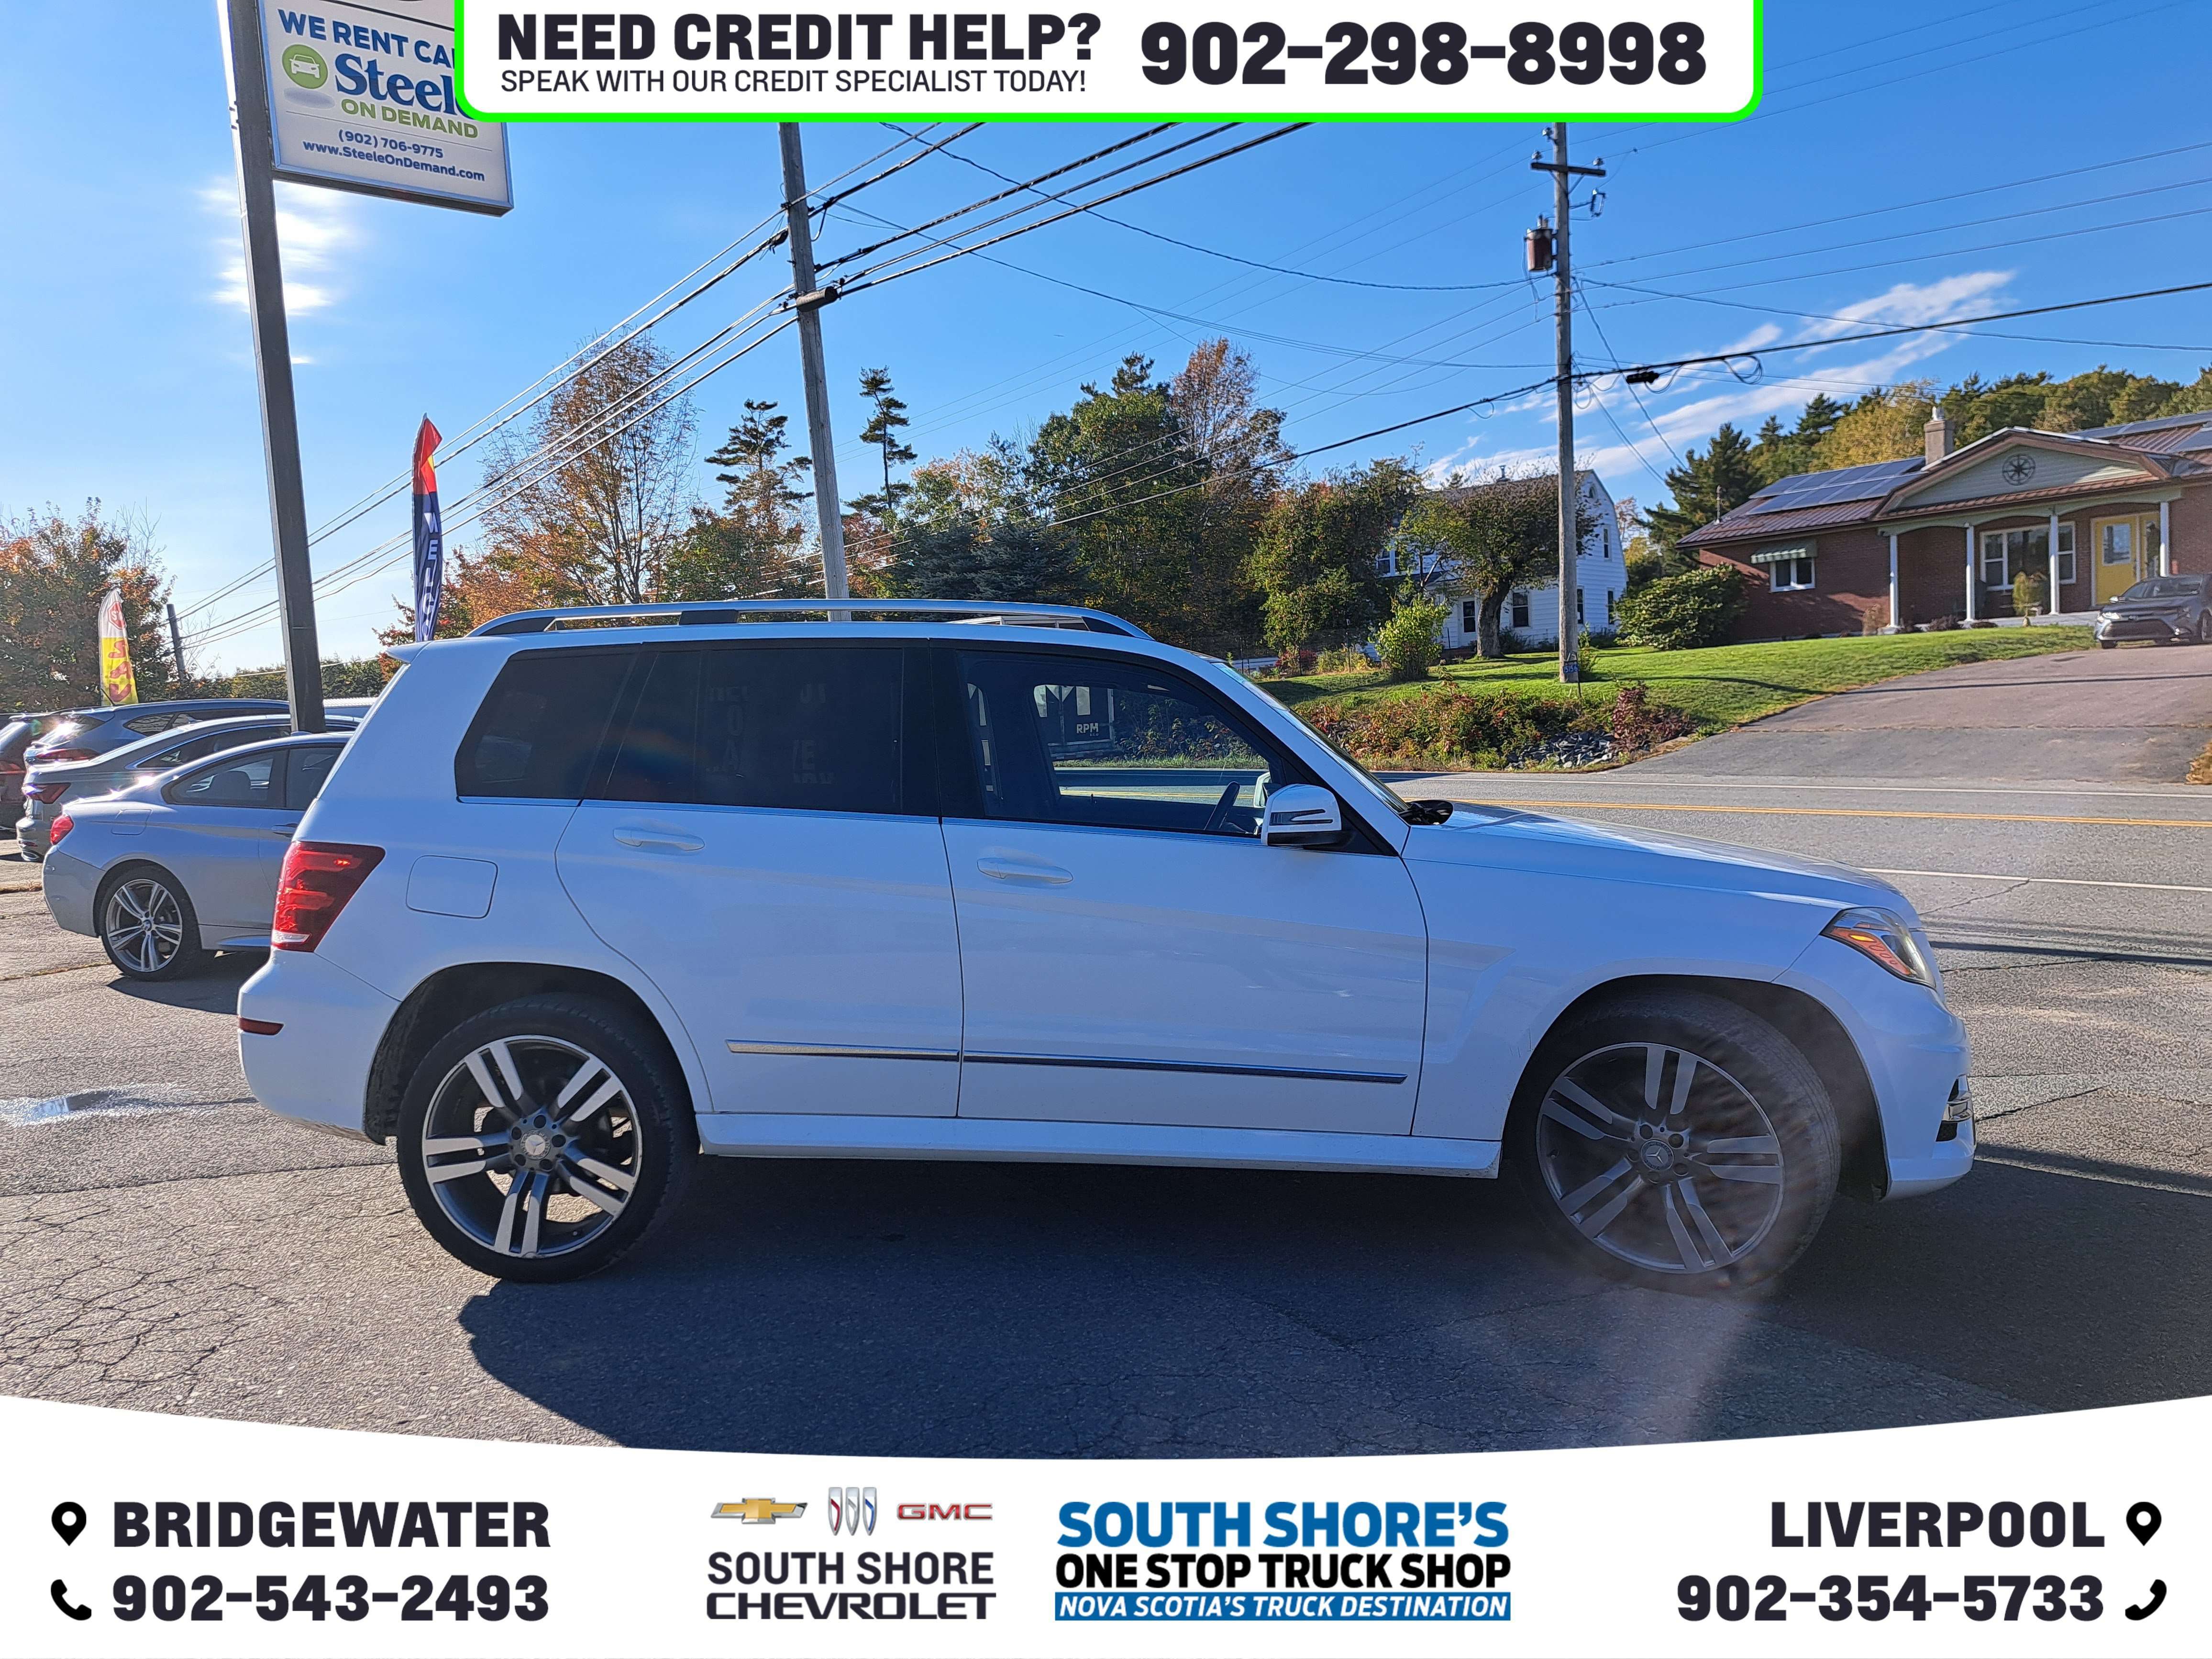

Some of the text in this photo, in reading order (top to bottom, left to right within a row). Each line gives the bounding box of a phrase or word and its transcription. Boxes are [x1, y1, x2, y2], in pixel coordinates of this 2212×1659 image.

[277, 9, 454, 69] WE RENT CA
[341, 99, 478, 138] ON DEMAND
[303, 142, 485, 181] www.SteeleOnDemand.com
[338, 129, 443, 158] (902) 706-9775
[1077, 723, 1098, 733] RPM
